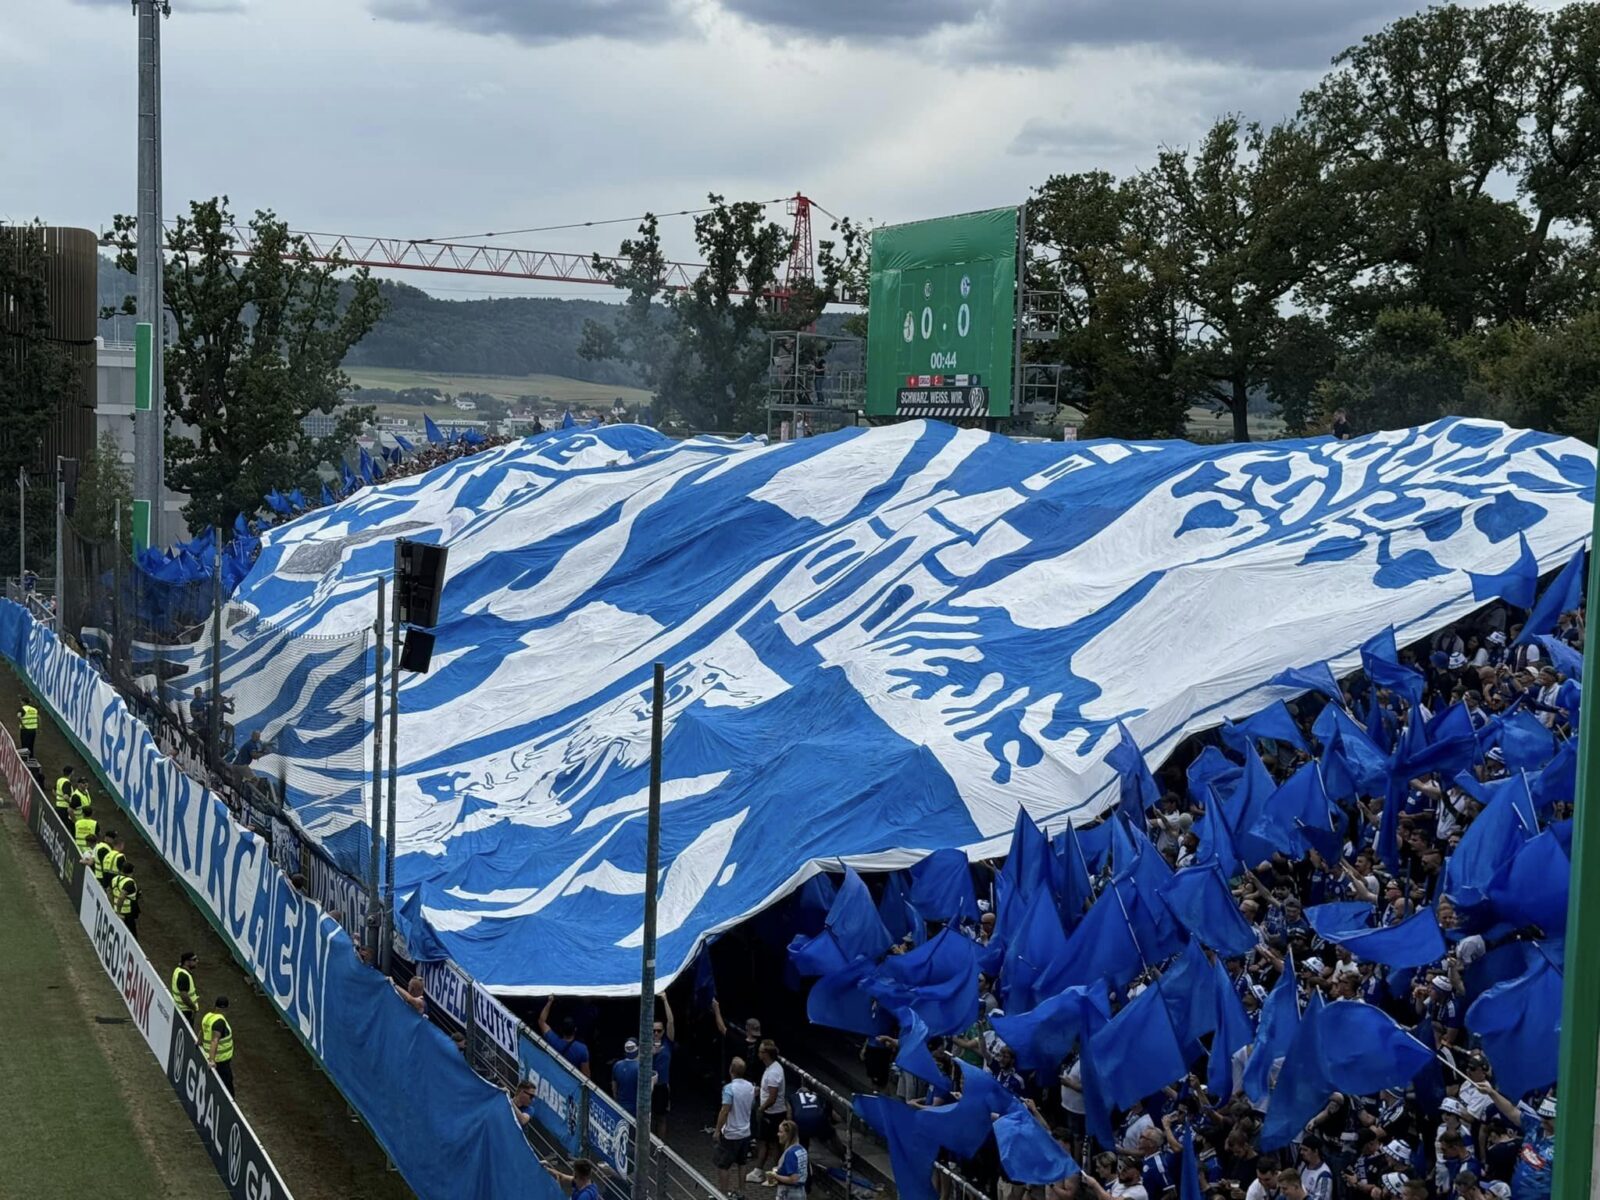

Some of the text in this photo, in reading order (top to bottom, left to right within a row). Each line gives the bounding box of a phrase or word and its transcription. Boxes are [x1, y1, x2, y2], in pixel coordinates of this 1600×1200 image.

[921, 303, 970, 340] 0 0
[930, 351, 957, 369] 00:44
[100, 695, 329, 1062] GELSENKIRCHEN
